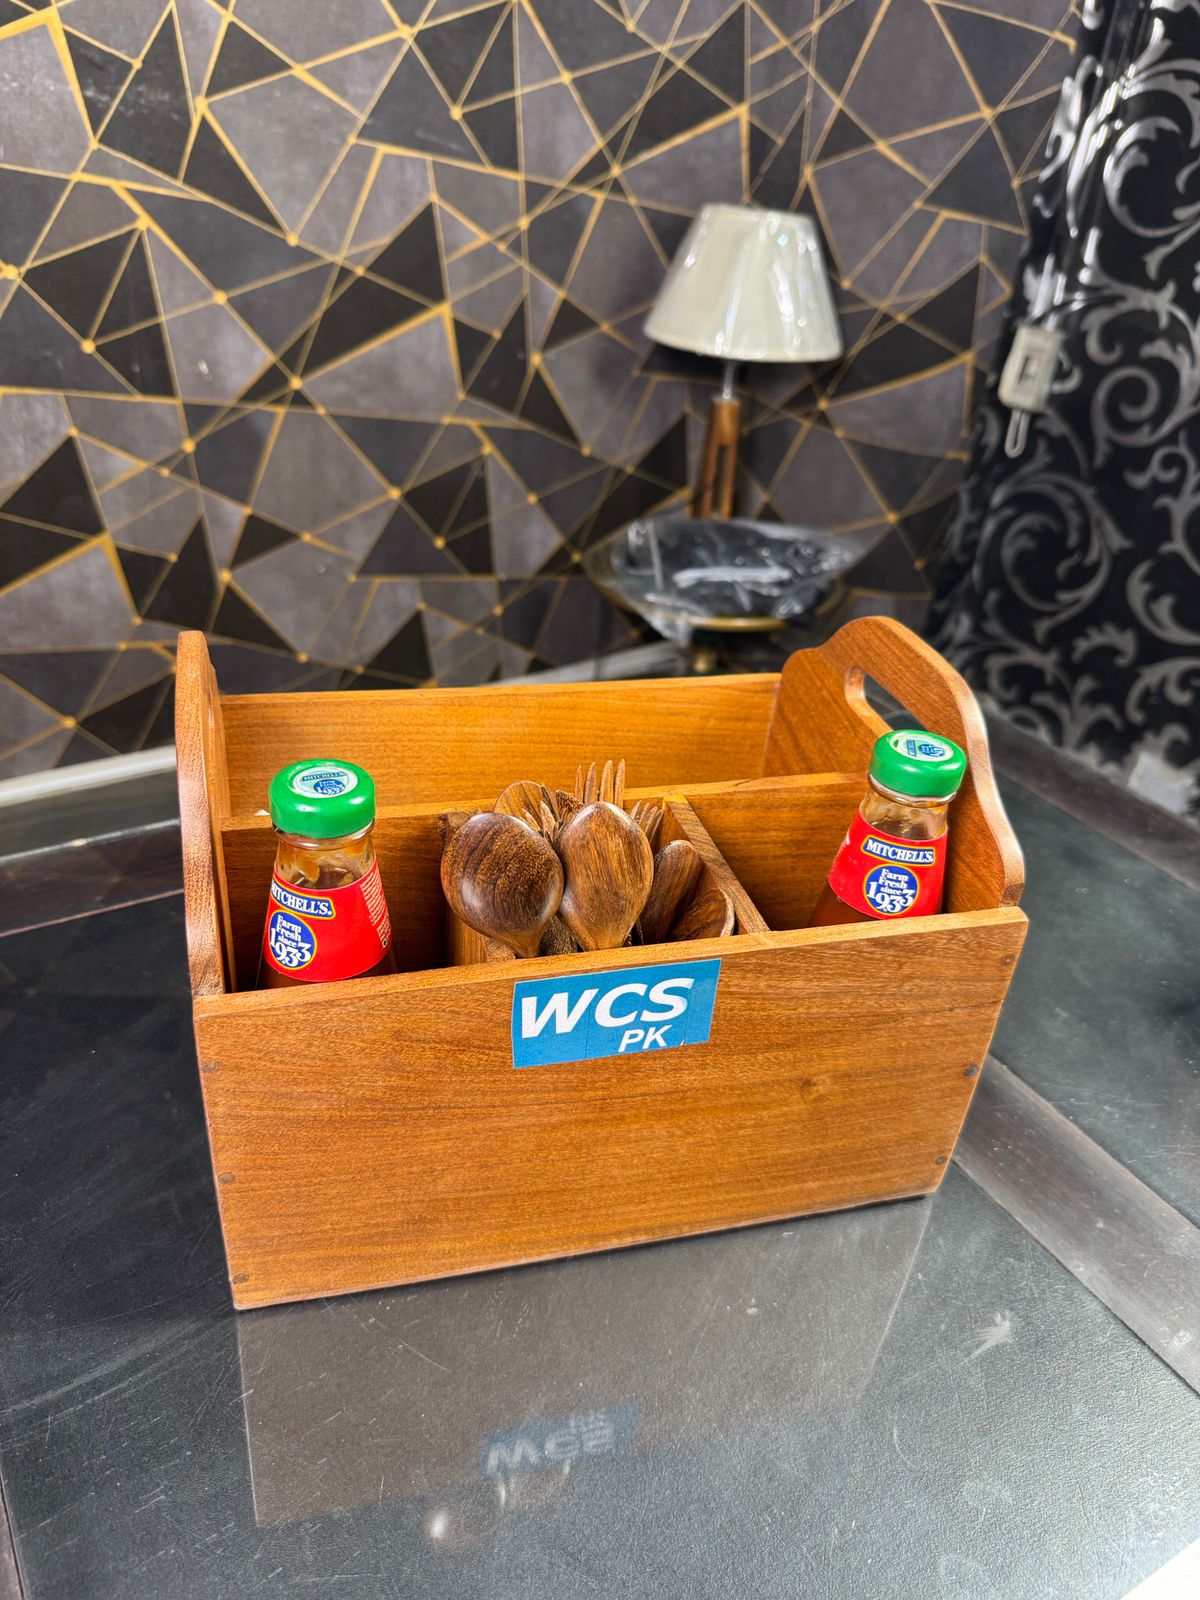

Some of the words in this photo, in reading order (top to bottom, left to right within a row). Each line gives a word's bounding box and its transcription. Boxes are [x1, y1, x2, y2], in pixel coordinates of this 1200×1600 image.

[866, 839, 933, 863] MITCHELL'S
[879, 876, 907, 889] Fresh
[881, 868, 909, 881] Farm
[867, 881, 915, 912] 1933
[880, 887, 902, 896] since
[277, 923, 302, 942] Fresh
[278, 914, 302, 933] Farm
[270, 928, 312, 967] 1933
[521, 978, 695, 1038] WCS
[618, 1025, 672, 1052] PK
